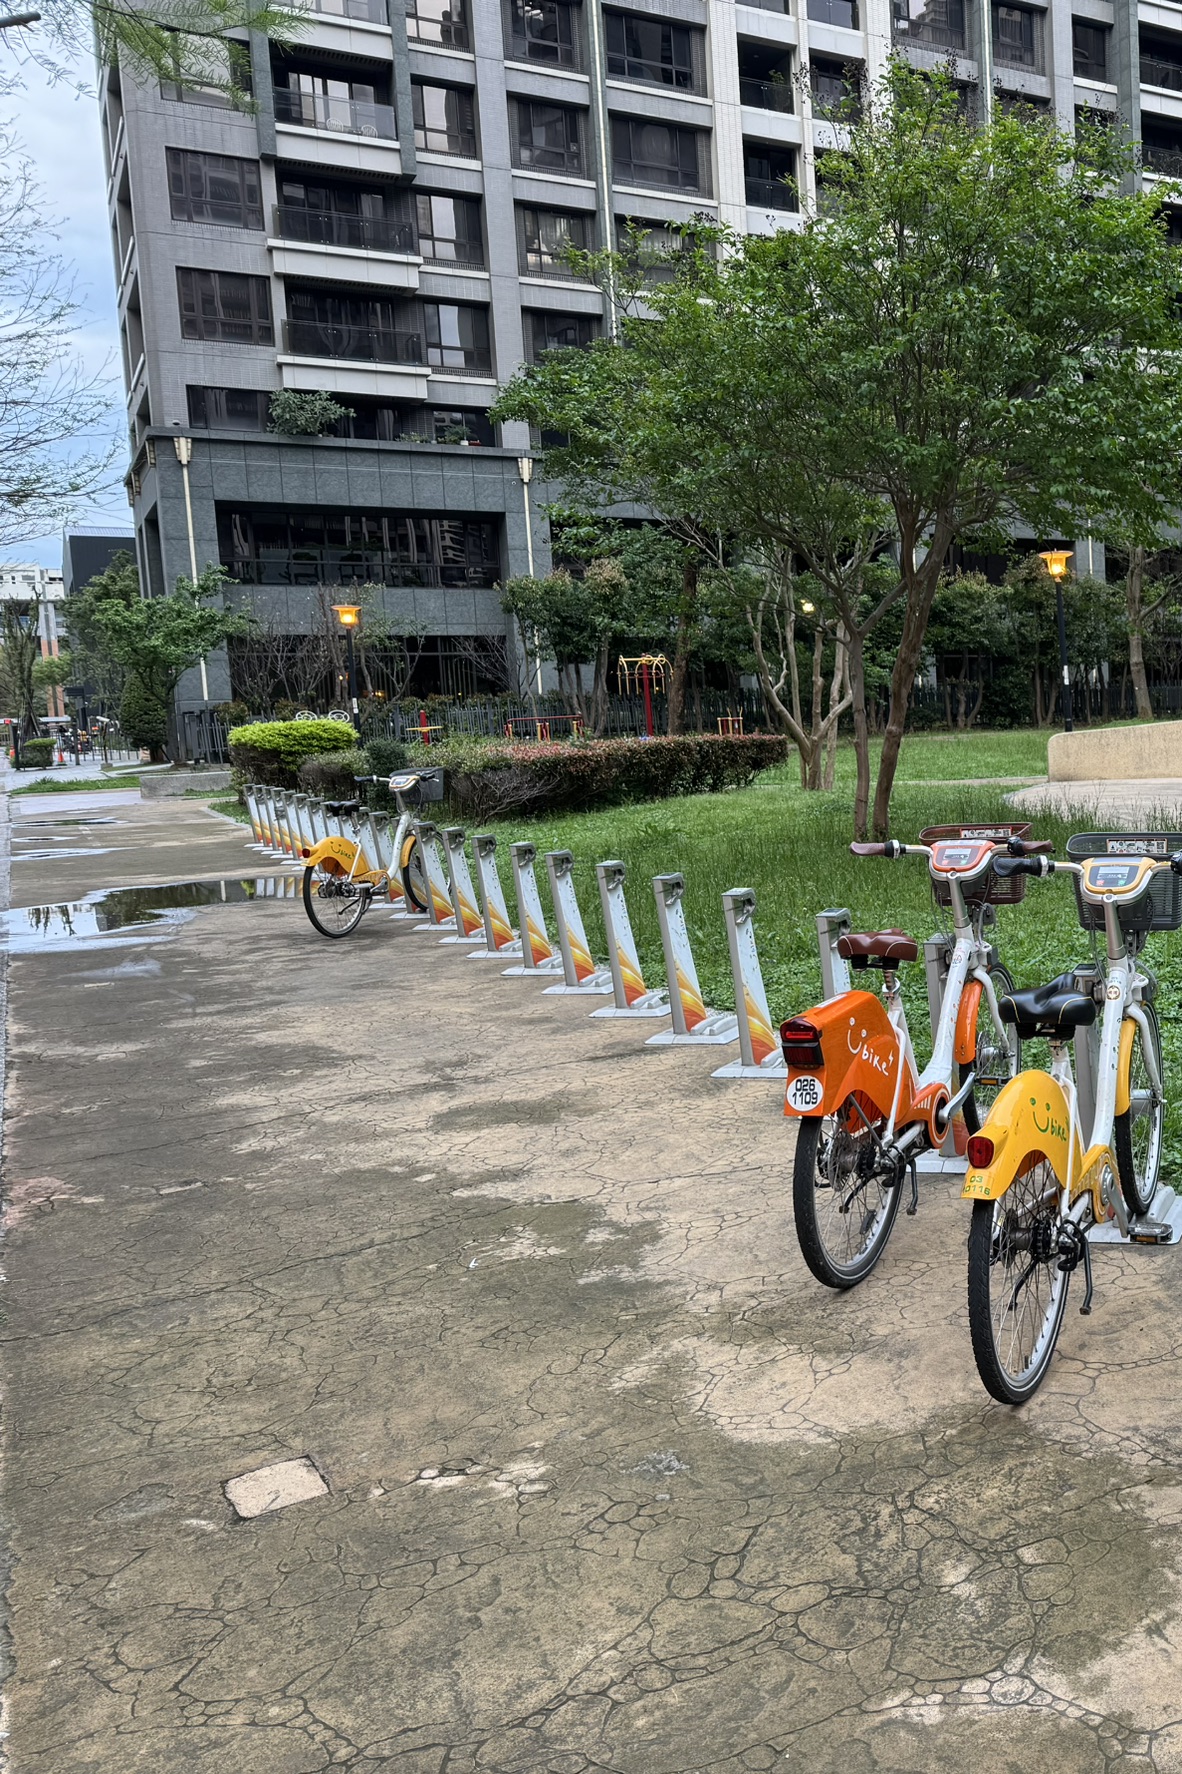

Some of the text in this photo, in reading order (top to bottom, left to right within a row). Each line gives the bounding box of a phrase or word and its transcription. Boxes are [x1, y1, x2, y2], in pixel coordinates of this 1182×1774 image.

[795, 1078, 816, 1092] 026
[792, 1092, 818, 1105] 1109
[970, 1175, 983, 1183] 03
